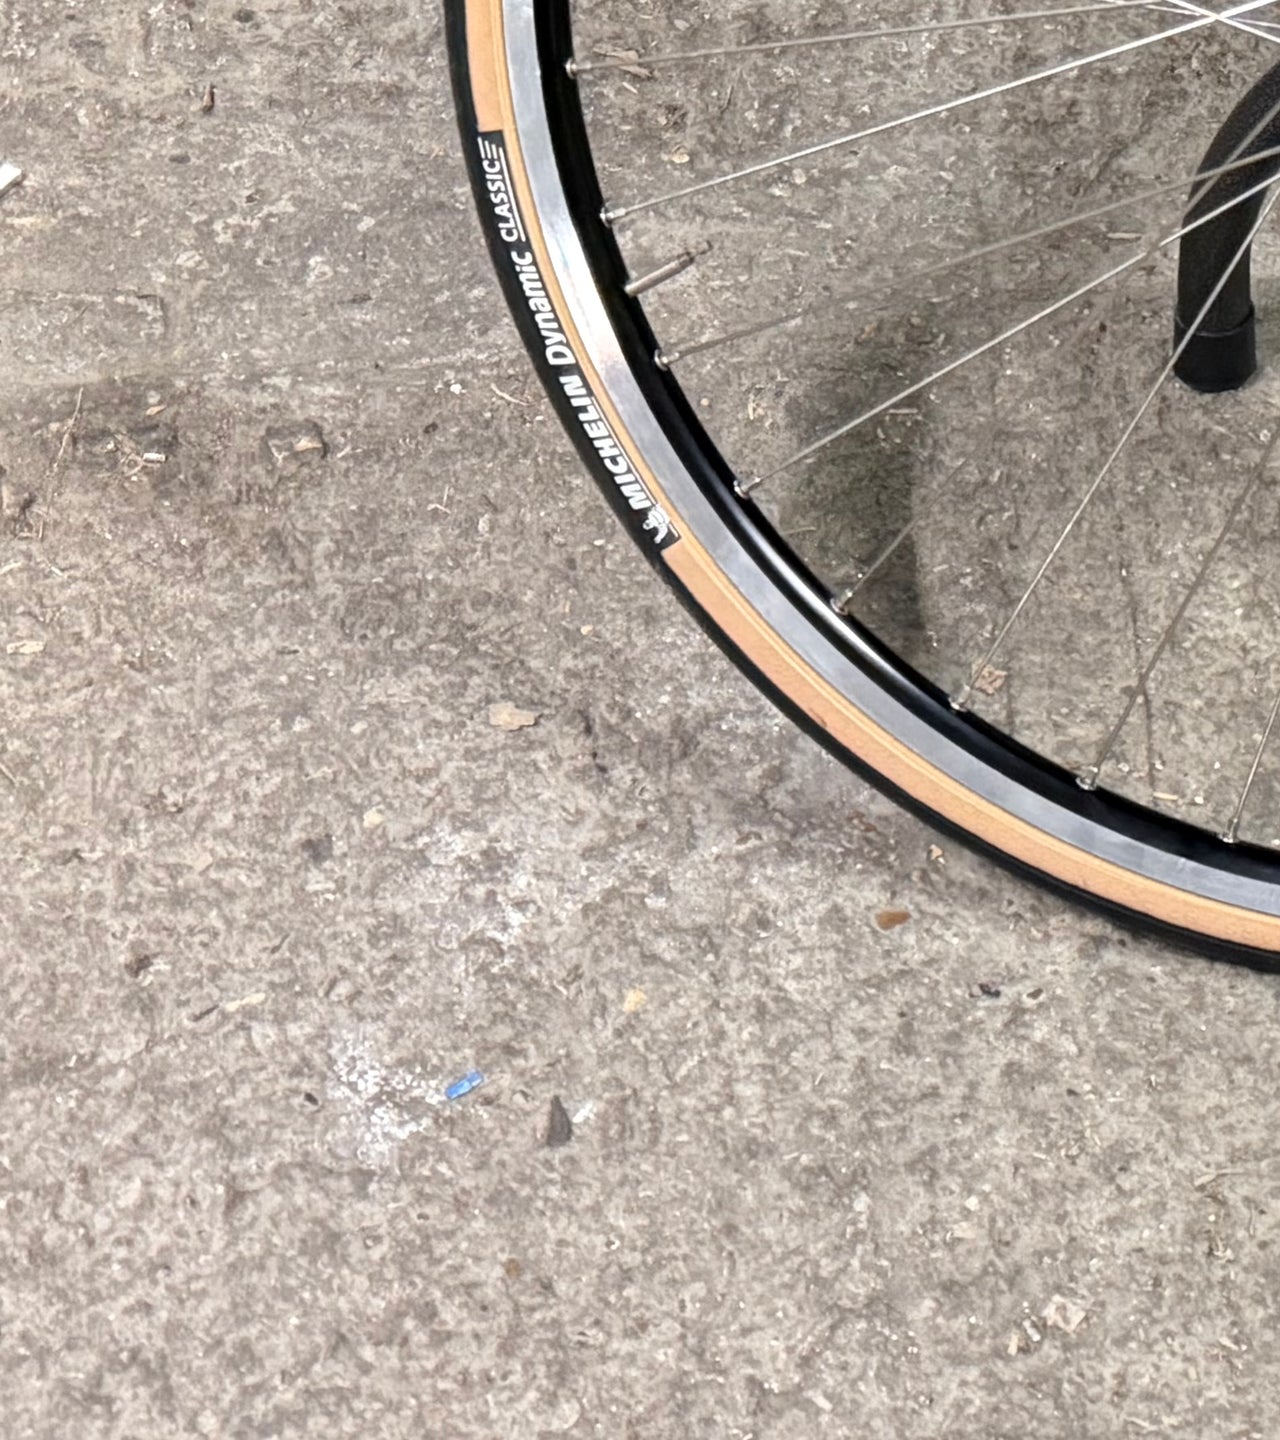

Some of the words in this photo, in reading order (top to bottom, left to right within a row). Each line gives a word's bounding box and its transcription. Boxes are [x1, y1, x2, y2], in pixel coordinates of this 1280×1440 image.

[486, 158, 519, 244] CLASSIC
[510, 250, 577, 367] Dynamic
[558, 374, 655, 511] MICHELIN
